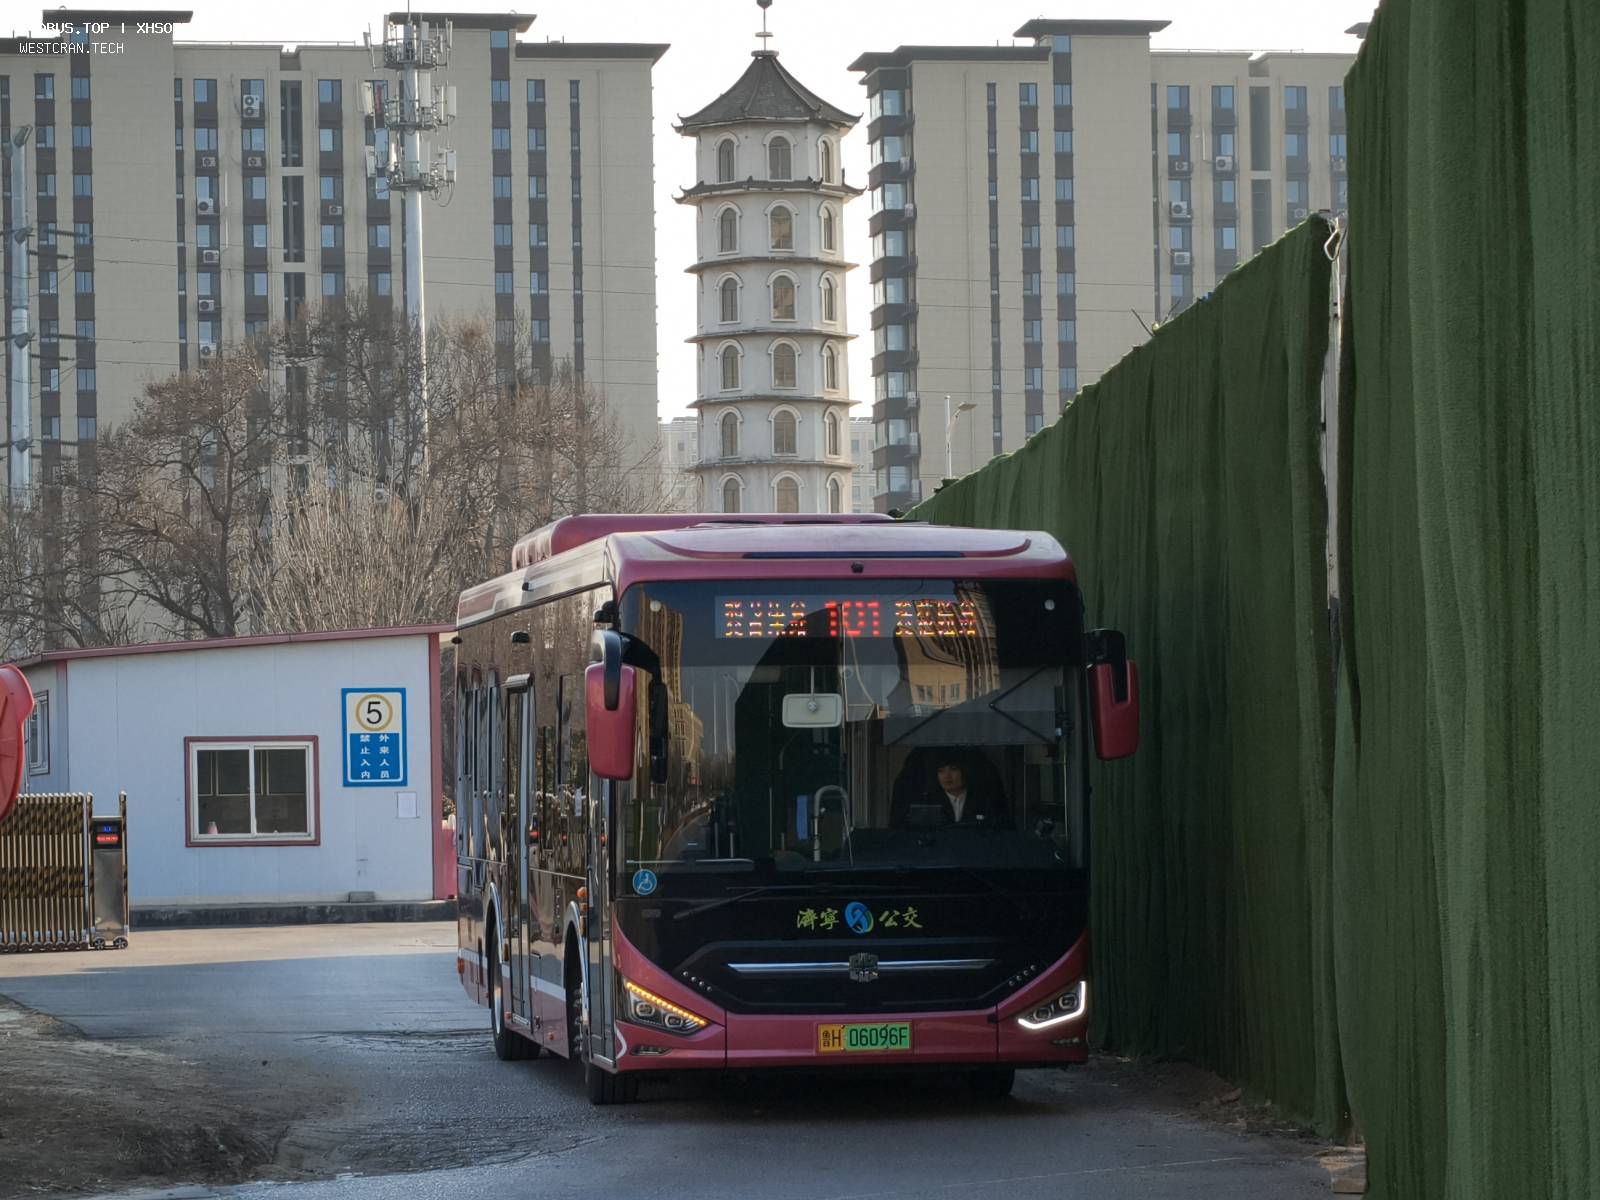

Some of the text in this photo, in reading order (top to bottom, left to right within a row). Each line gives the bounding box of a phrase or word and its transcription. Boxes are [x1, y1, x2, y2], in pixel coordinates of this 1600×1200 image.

[825, 601, 881, 637] 101
[366, 701, 382, 724] 5
[360, 734, 371, 779] 禁止入内
[379, 734, 390, 779] 外来人员
[879, 906, 923, 928] 公交
